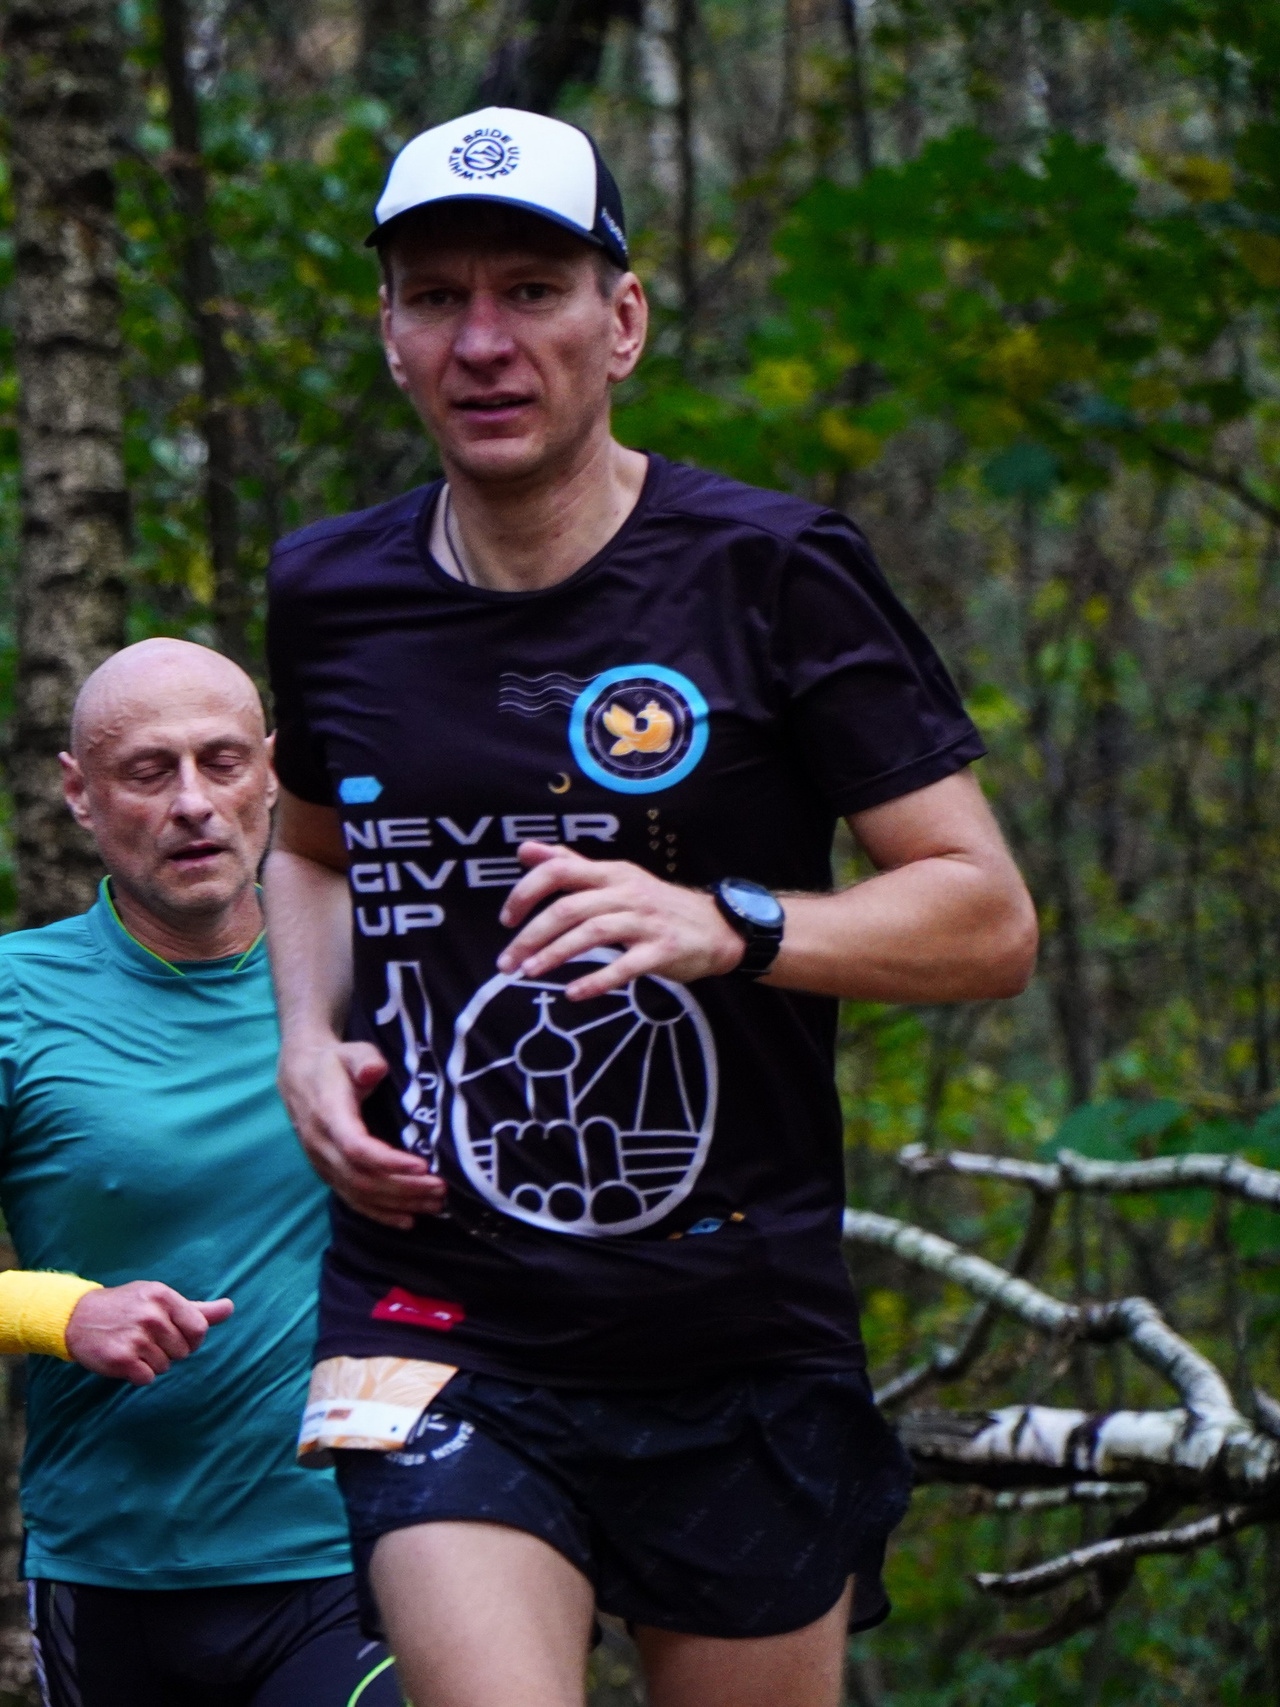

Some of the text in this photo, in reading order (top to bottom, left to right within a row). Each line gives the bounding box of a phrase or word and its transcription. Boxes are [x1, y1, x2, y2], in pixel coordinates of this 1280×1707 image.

[448, 128, 520, 181] WHITE BRIDE ULTRA
[343, 811, 620, 851] NEVER
[350, 857, 521, 894] GIVE
[356, 903, 446, 937] UP
